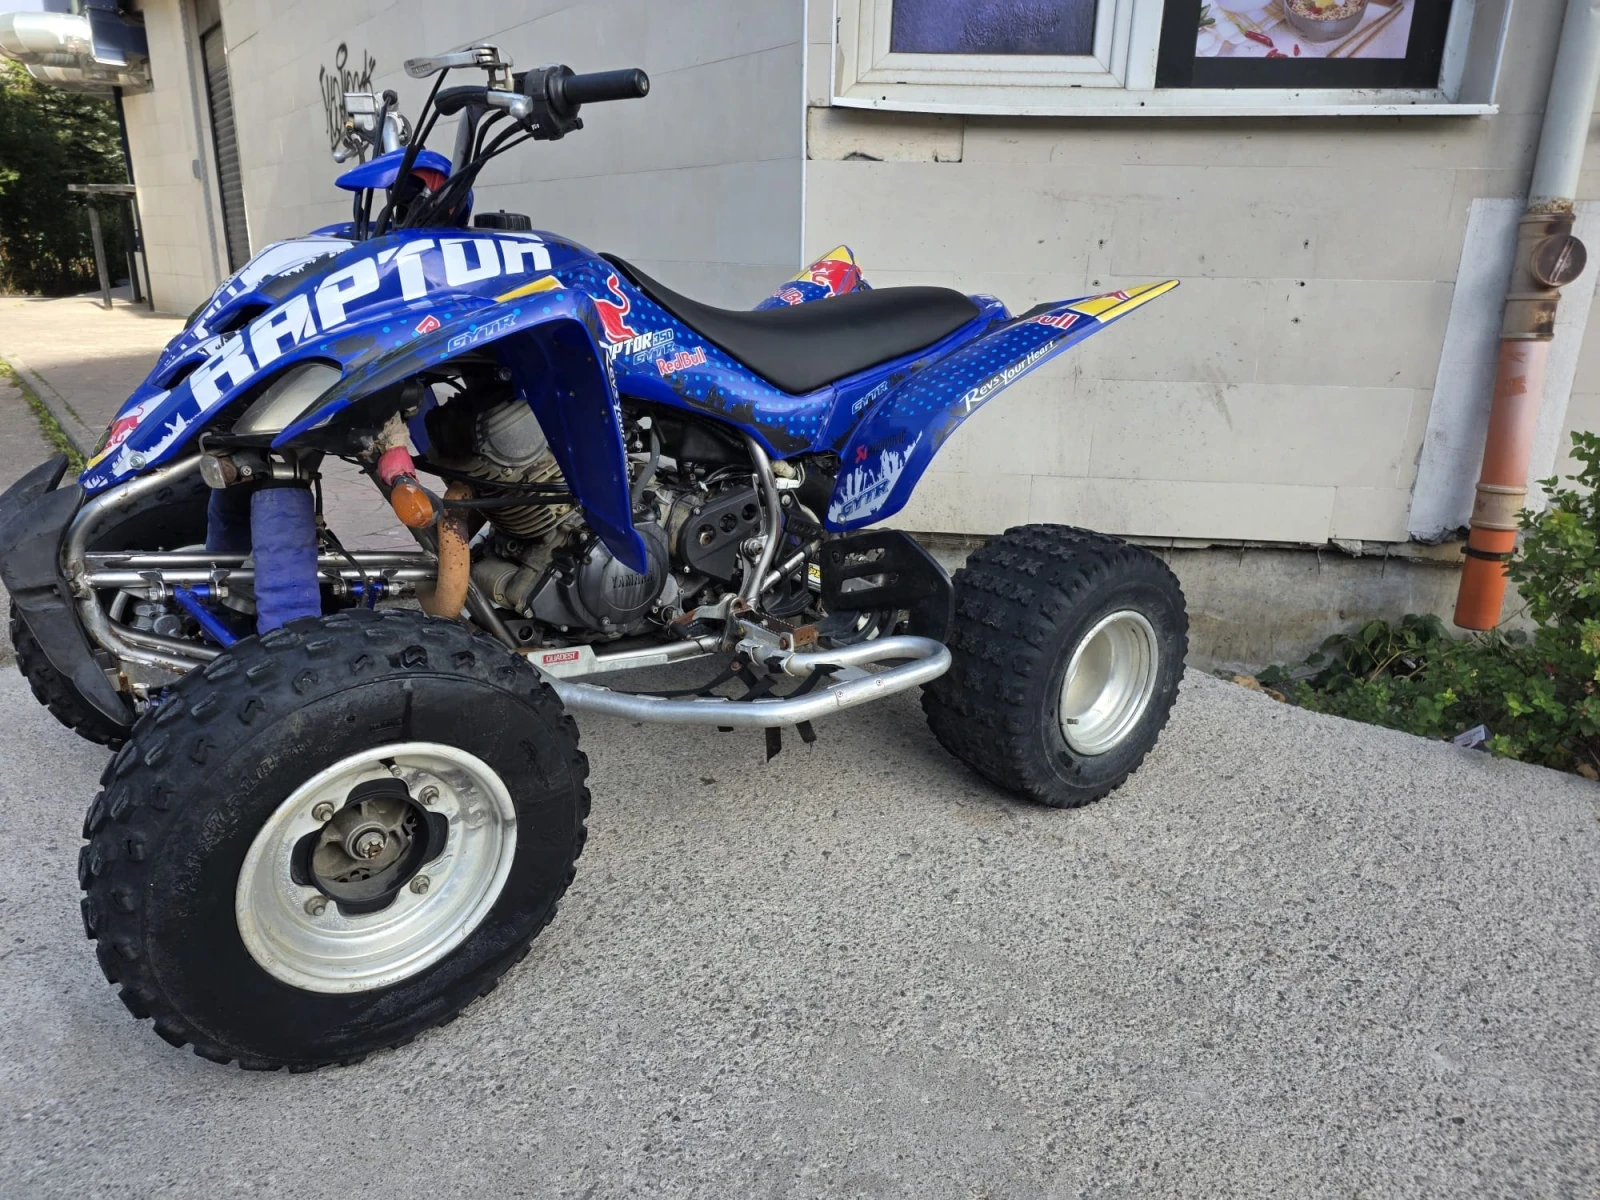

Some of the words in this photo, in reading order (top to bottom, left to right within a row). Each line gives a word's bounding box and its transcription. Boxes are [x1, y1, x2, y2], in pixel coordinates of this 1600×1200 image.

[189, 232, 552, 412] RAPTOR
[448, 314, 516, 352] GYTR
[607, 332, 652, 360] PTOR
[653, 328, 674, 346] 350
[959, 375, 1000, 412] Revs
[1000, 360, 1025, 385] Your
[1027, 341, 1054, 365] Heart
[852, 381, 889, 415] GYTR
[841, 478, 890, 517] GYTR
